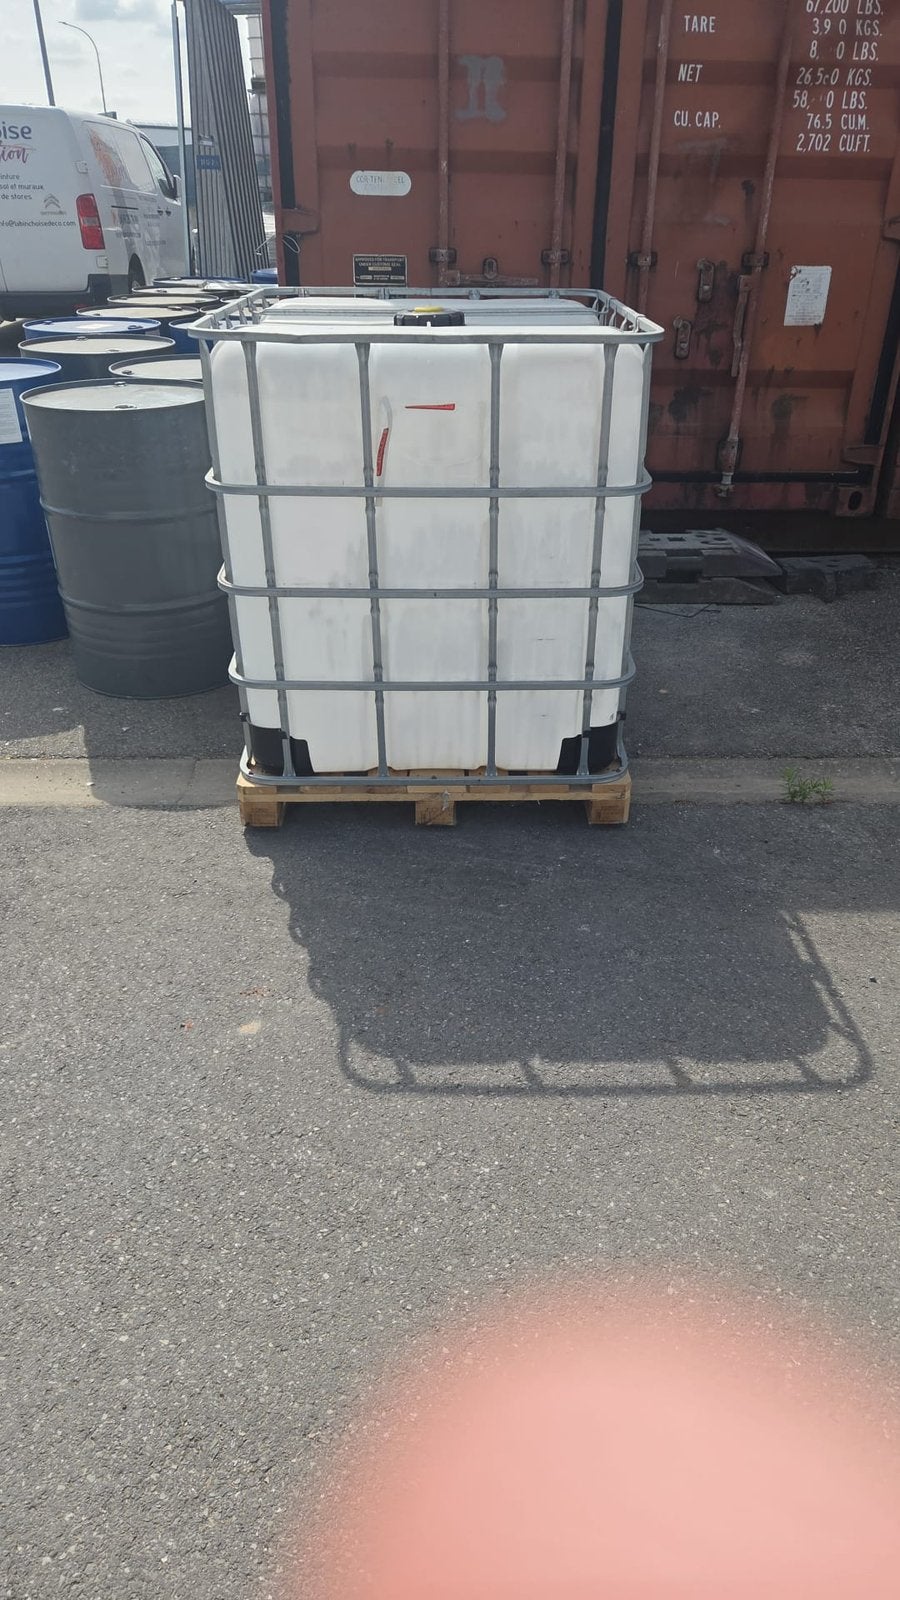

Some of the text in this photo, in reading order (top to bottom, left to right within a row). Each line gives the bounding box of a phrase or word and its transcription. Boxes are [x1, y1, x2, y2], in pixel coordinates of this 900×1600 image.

[805, 0, 884, 15] 67,200 LBS.
[684, 15, 716, 33] TARE
[855, 19, 883, 36] KGS.
[852, 41, 879, 61] LBS.
[677, 63, 703, 82] NET
[846, 68, 872, 86] KGS.
[842, 91, 867, 110] LBS.
[673, 110, 692, 127] CU.
[695, 111, 721, 128] CAP.
[807, 113, 832, 129] 76.5
[0, 121, 33, 140] ise
[796, 133, 832, 152] 2,702
